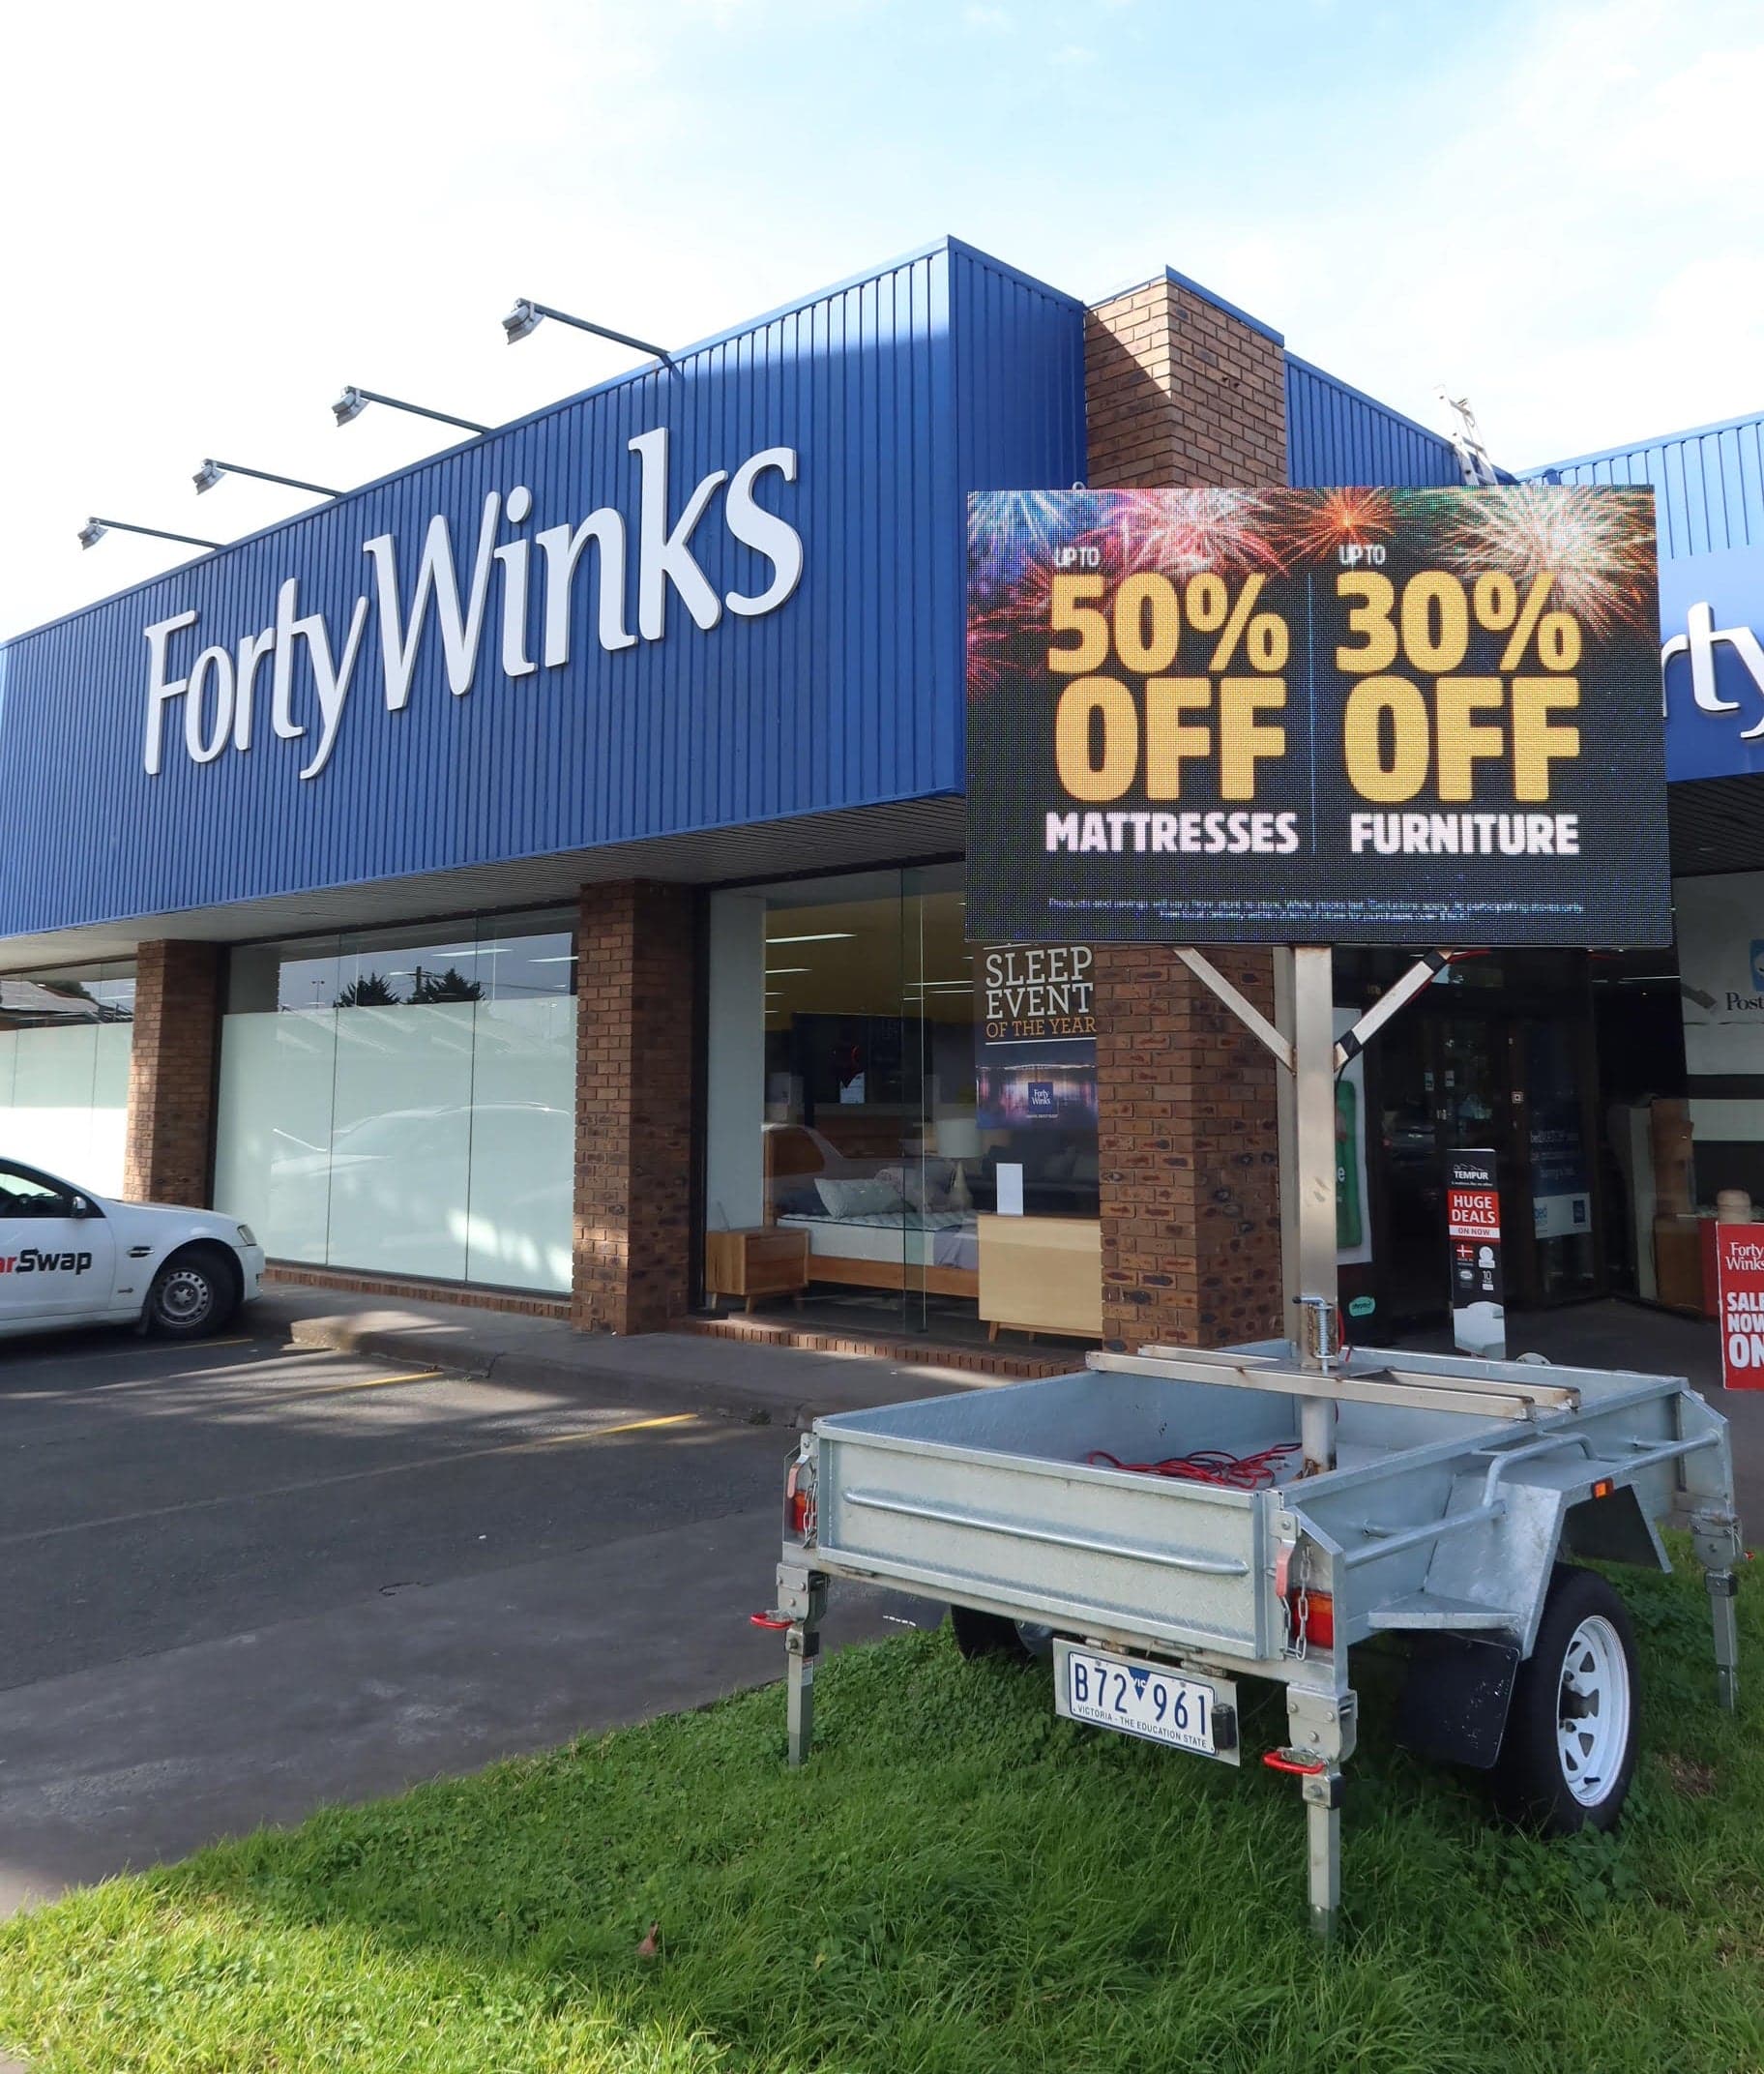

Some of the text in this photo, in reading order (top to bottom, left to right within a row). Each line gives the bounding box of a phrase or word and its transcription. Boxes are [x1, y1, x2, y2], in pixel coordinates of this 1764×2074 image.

[1054, 547, 1101, 567] UP TO
[1338, 544, 1386, 566] UP TO
[1048, 571, 1290, 674] 50%
[1336, 570, 1582, 673] 30%
[1055, 676, 1287, 802] OFF
[1344, 675, 1581, 803] OFF
[1045, 812, 1300, 854] MATTRESSES
[1350, 813, 1580, 855] FURNITURE
[985, 946, 1093, 988] SLEEP
[985, 983, 1094, 1019] EVENT
[985, 1017, 1097, 1038] OF THE YEAR
[1454, 1170, 1489, 1180] TEMPUR
[1452, 1209, 1496, 1224] DEALS
[1453, 1195, 1492, 1209] HUGE
[1074, 1662, 1206, 1735] B72 961
[1078, 1704, 1113, 1721] VICTORIA
[1120, 1716, 1135, 1728] THE
[1136, 1721, 1181, 1740] EDUCATION
[1183, 1734, 1207, 1748] STATE
